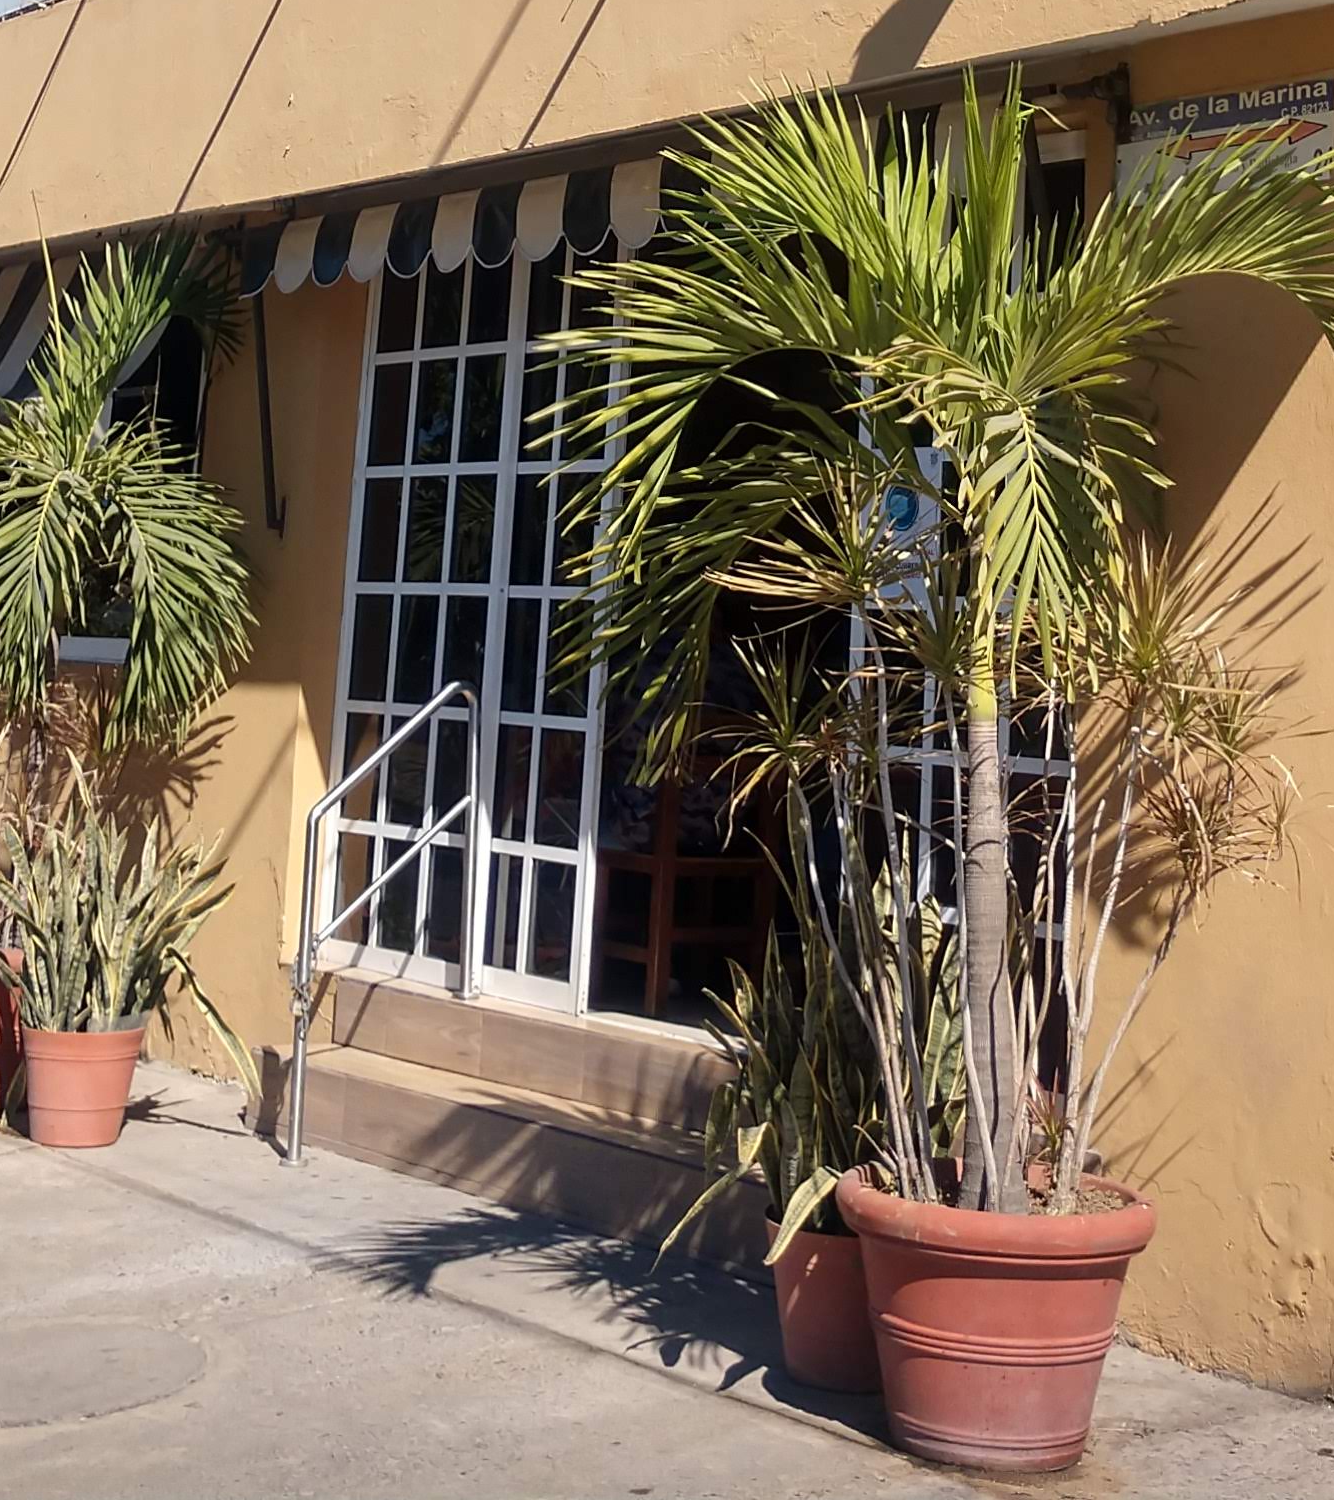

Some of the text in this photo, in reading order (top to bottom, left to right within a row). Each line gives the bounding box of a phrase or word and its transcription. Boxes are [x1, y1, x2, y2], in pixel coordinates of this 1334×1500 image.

[1129, 80, 1329, 128] Av. de la Marina
